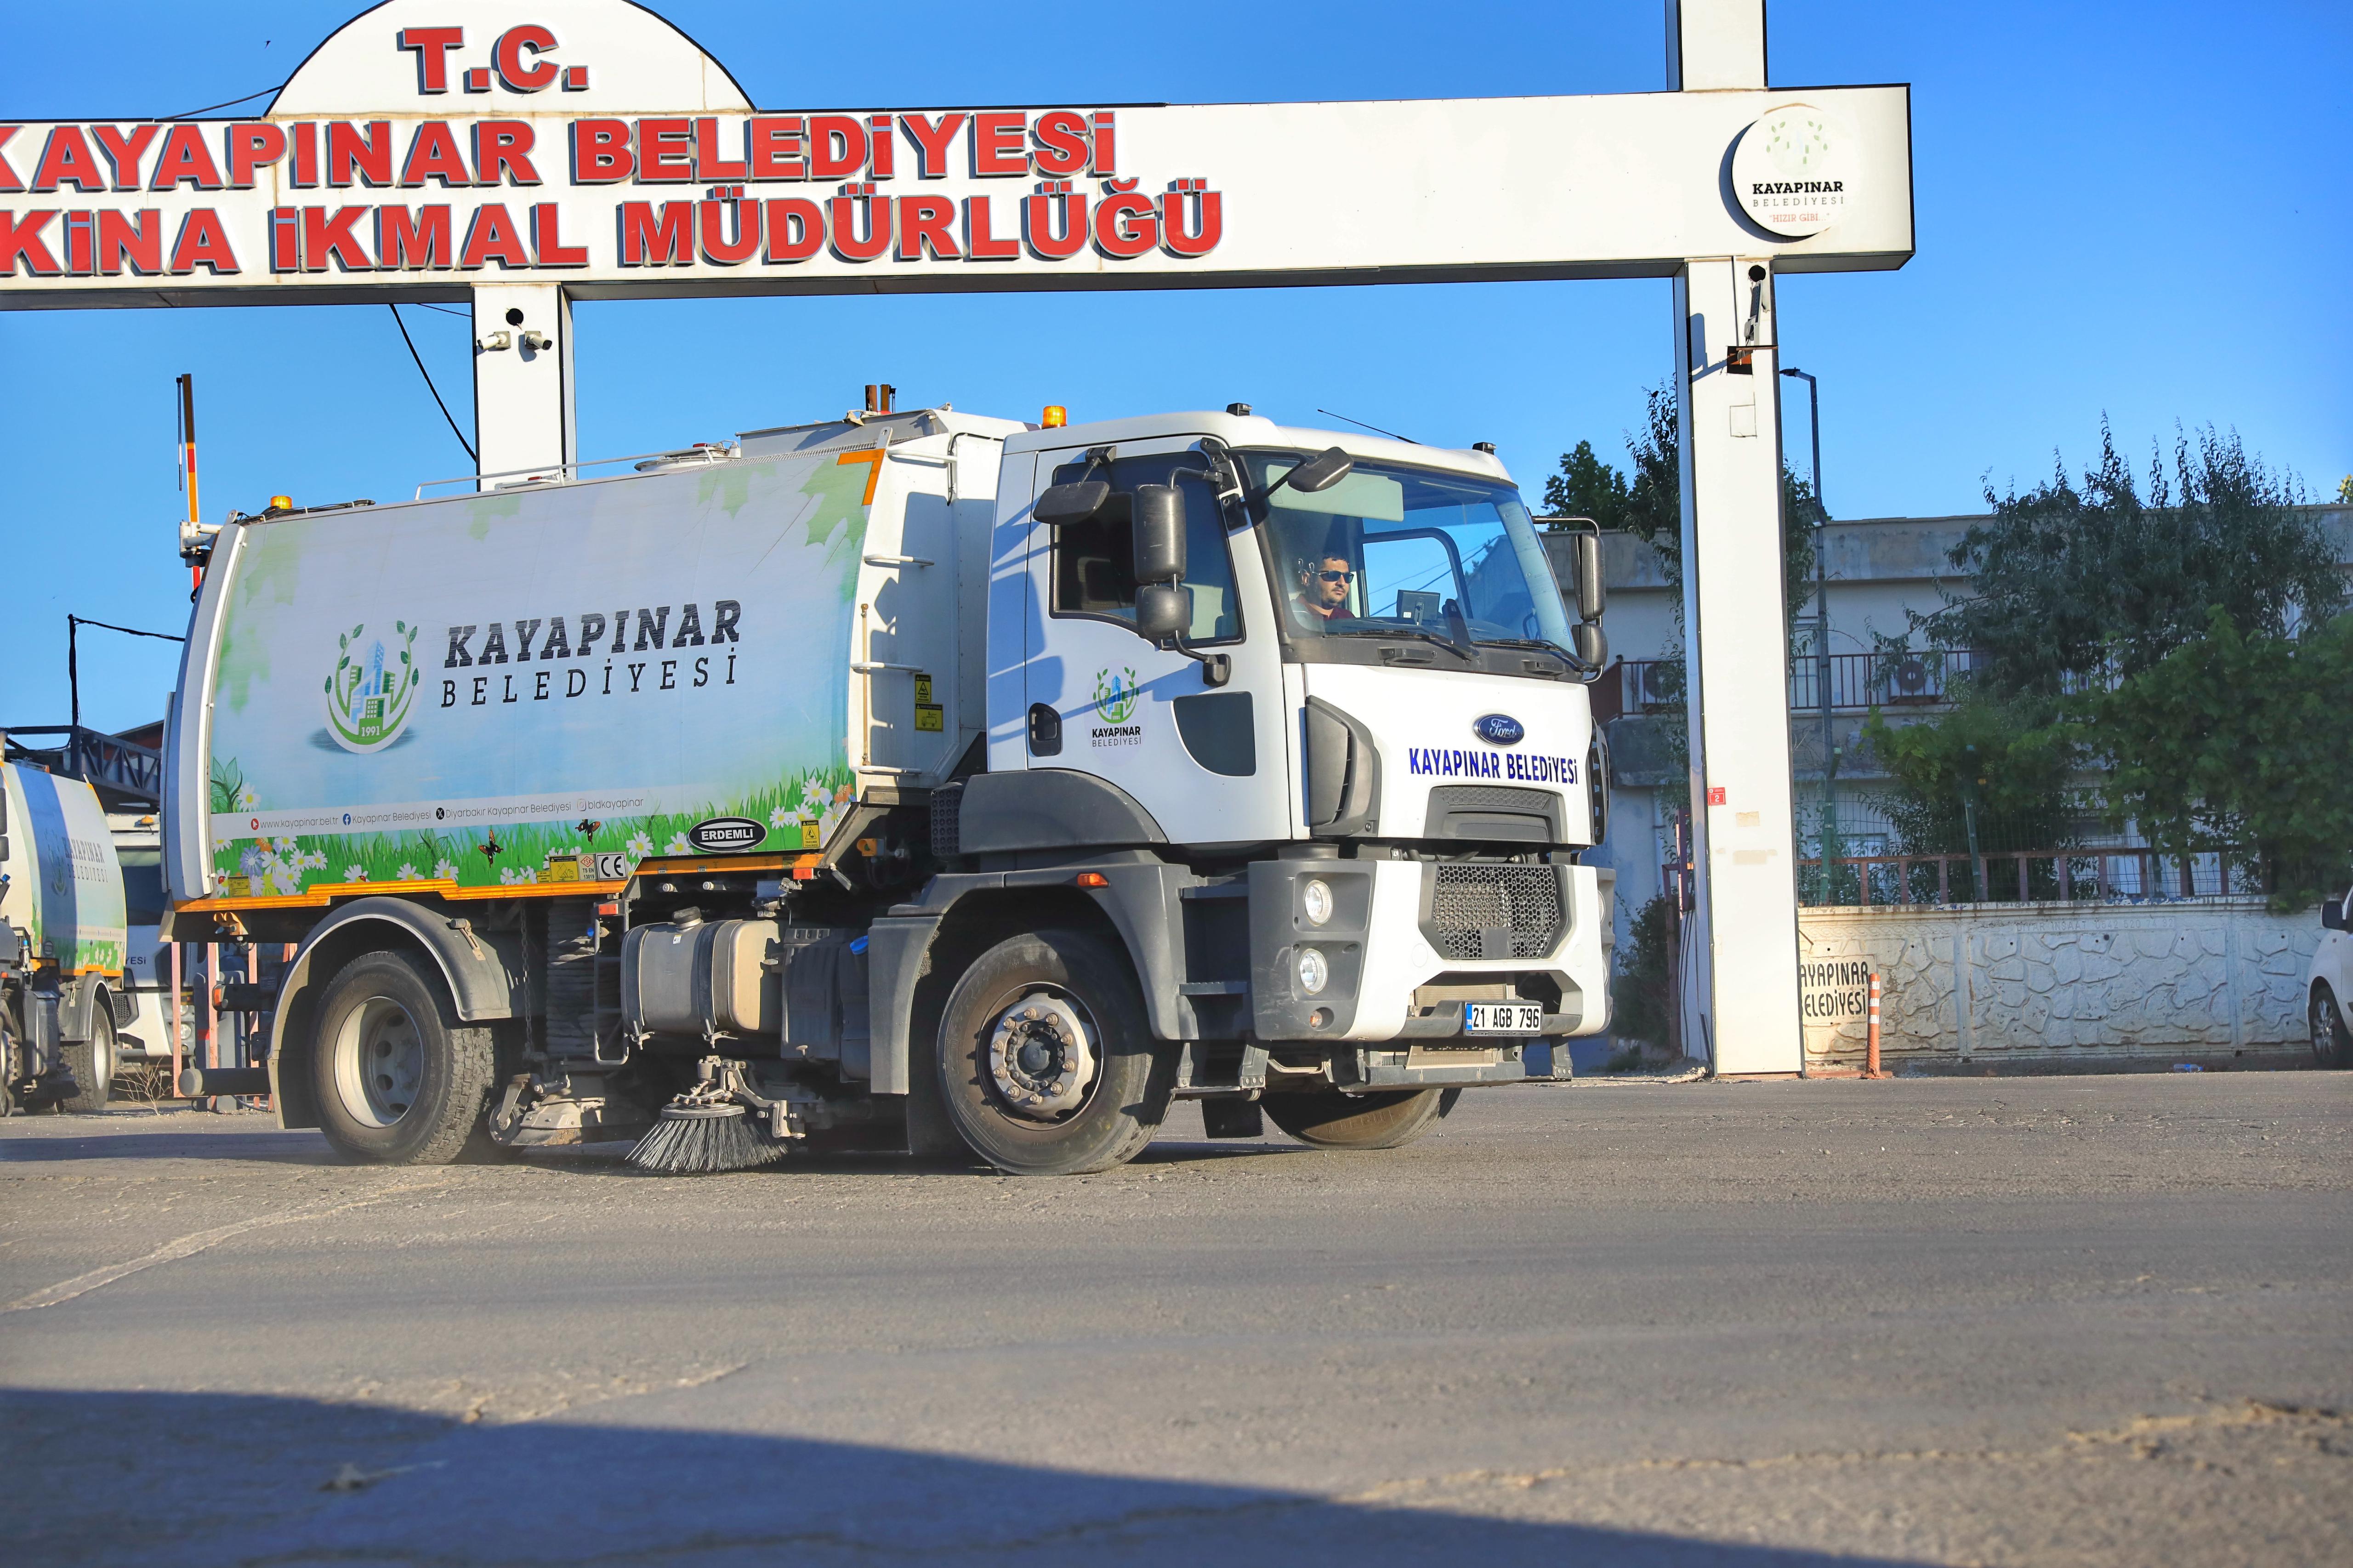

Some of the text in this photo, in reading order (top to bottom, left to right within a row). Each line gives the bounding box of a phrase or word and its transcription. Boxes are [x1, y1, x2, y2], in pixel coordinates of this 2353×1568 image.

[402, 23, 589, 93] T.C.
[1752, 181, 1843, 194] KAYAPINAR
[1753, 195, 1843, 207] BELEDİYESİ
[621, 176, 1222, 266] MÜDÜRLÜĞÜ
[443, 599, 742, 669] KAYAPINAR
[441, 647, 737, 708] BELEDİYESİ
[361, 726, 380, 737] 1991
[1092, 726, 1141, 738] KAYAPINAR
[1489, 718, 1516, 738] Ford
[1092, 736, 1141, 747] BELEDİYESİ
[1409, 748, 1500, 778] KAYAPINAR
[446, 801, 571, 819] Diyarbakır Kayapınar Belediyesi
[588, 798, 644, 812] bldkayapinar
[260, 817, 339, 830] www.kayapinar.bel.tr
[352, 810, 431, 825] Kayapınar Belediyesi
[63, 837, 105, 863] KAYAPINAR
[67, 864, 108, 883] BELEDİYESİ
[1800, 961, 1869, 987] AYAPINAR
[1802, 988, 1866, 1017] ELEDİYESİ
[1473, 1007, 1484, 1027] 21
[1493, 1008, 1512, 1028] AGB
[1519, 1008, 1539, 1028] 796
